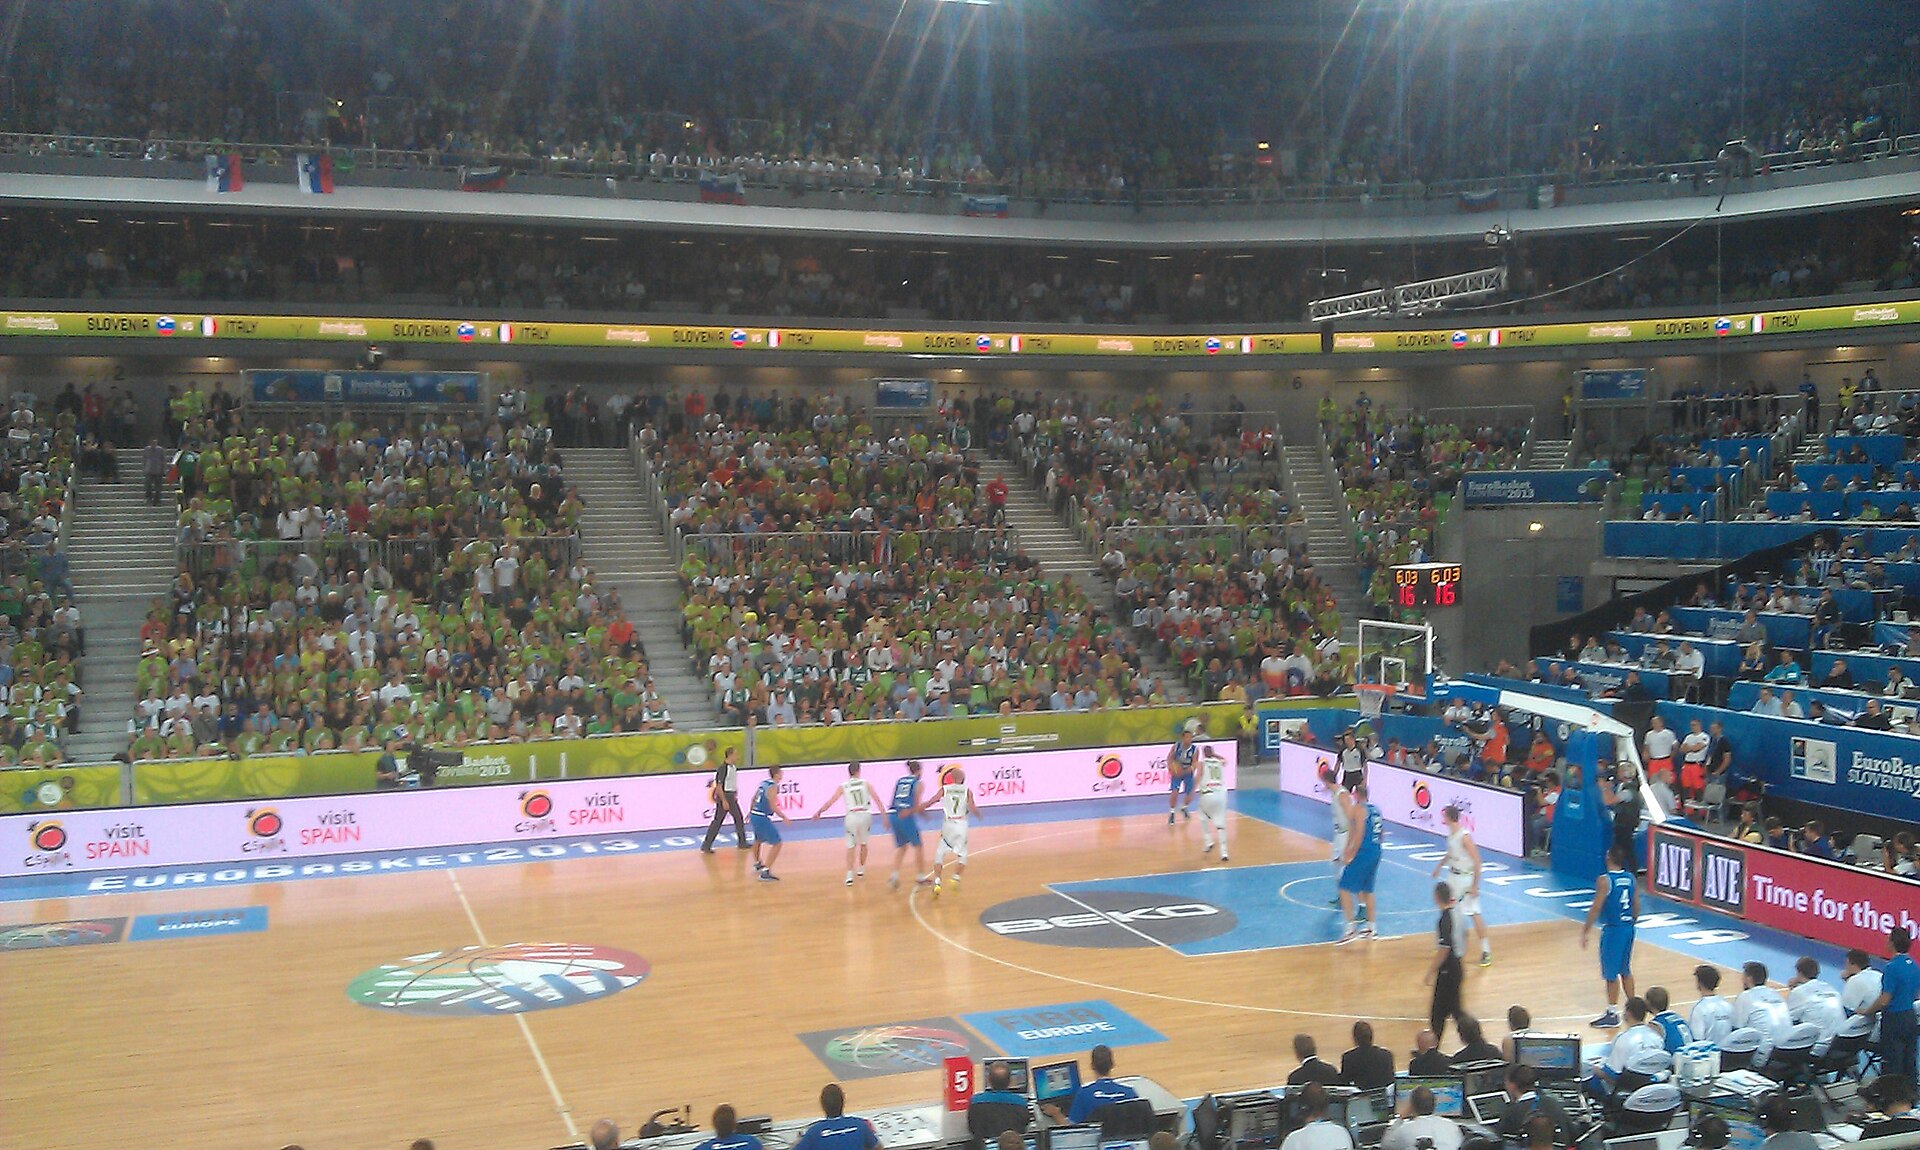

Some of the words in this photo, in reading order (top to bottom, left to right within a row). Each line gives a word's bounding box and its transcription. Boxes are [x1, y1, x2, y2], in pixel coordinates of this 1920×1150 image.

[87, 317, 150, 332] SLOVENIA
[225, 319, 258, 334] ITALY
[393, 323, 450, 337] SLOVENIA
[520, 327, 549, 339] ITALY
[1655, 319, 1709, 336] SLOVENIA
[672, 330, 724, 343] SLOVENIA
[1397, 333, 1446, 347] SLOVENIA
[1399, 584, 1416, 607] 16
[1434, 582, 1456, 606] 16
[479, 764, 511, 777] 2013
[1149, 756, 1167, 769] vis
[992, 765, 1022, 780] visit
[1136, 771, 1171, 786] SPAI
[776, 779, 801, 794] isit
[979, 780, 1025, 797] SPAIN
[585, 792, 620, 807] visit
[952, 796, 960, 814] 7
[318, 809, 357, 825] visit
[569, 807, 624, 826] SPAIN
[104, 822, 145, 839] visit
[300, 825, 360, 846] SPAIN
[86, 839, 150, 860] SPAIN
[1657, 842, 1691, 892] AVE
[1704, 854, 1741, 905] AVE
[1619, 888, 1631, 910] 4
[1752, 874, 1809, 913] Time
[1811, 888, 1849, 922] for
[1852, 900, 1896, 935] the
[986, 903, 1219, 935] BEKO
[1017, 1021, 1117, 1041] EUROPE
[954, 1070, 970, 1092] 5
